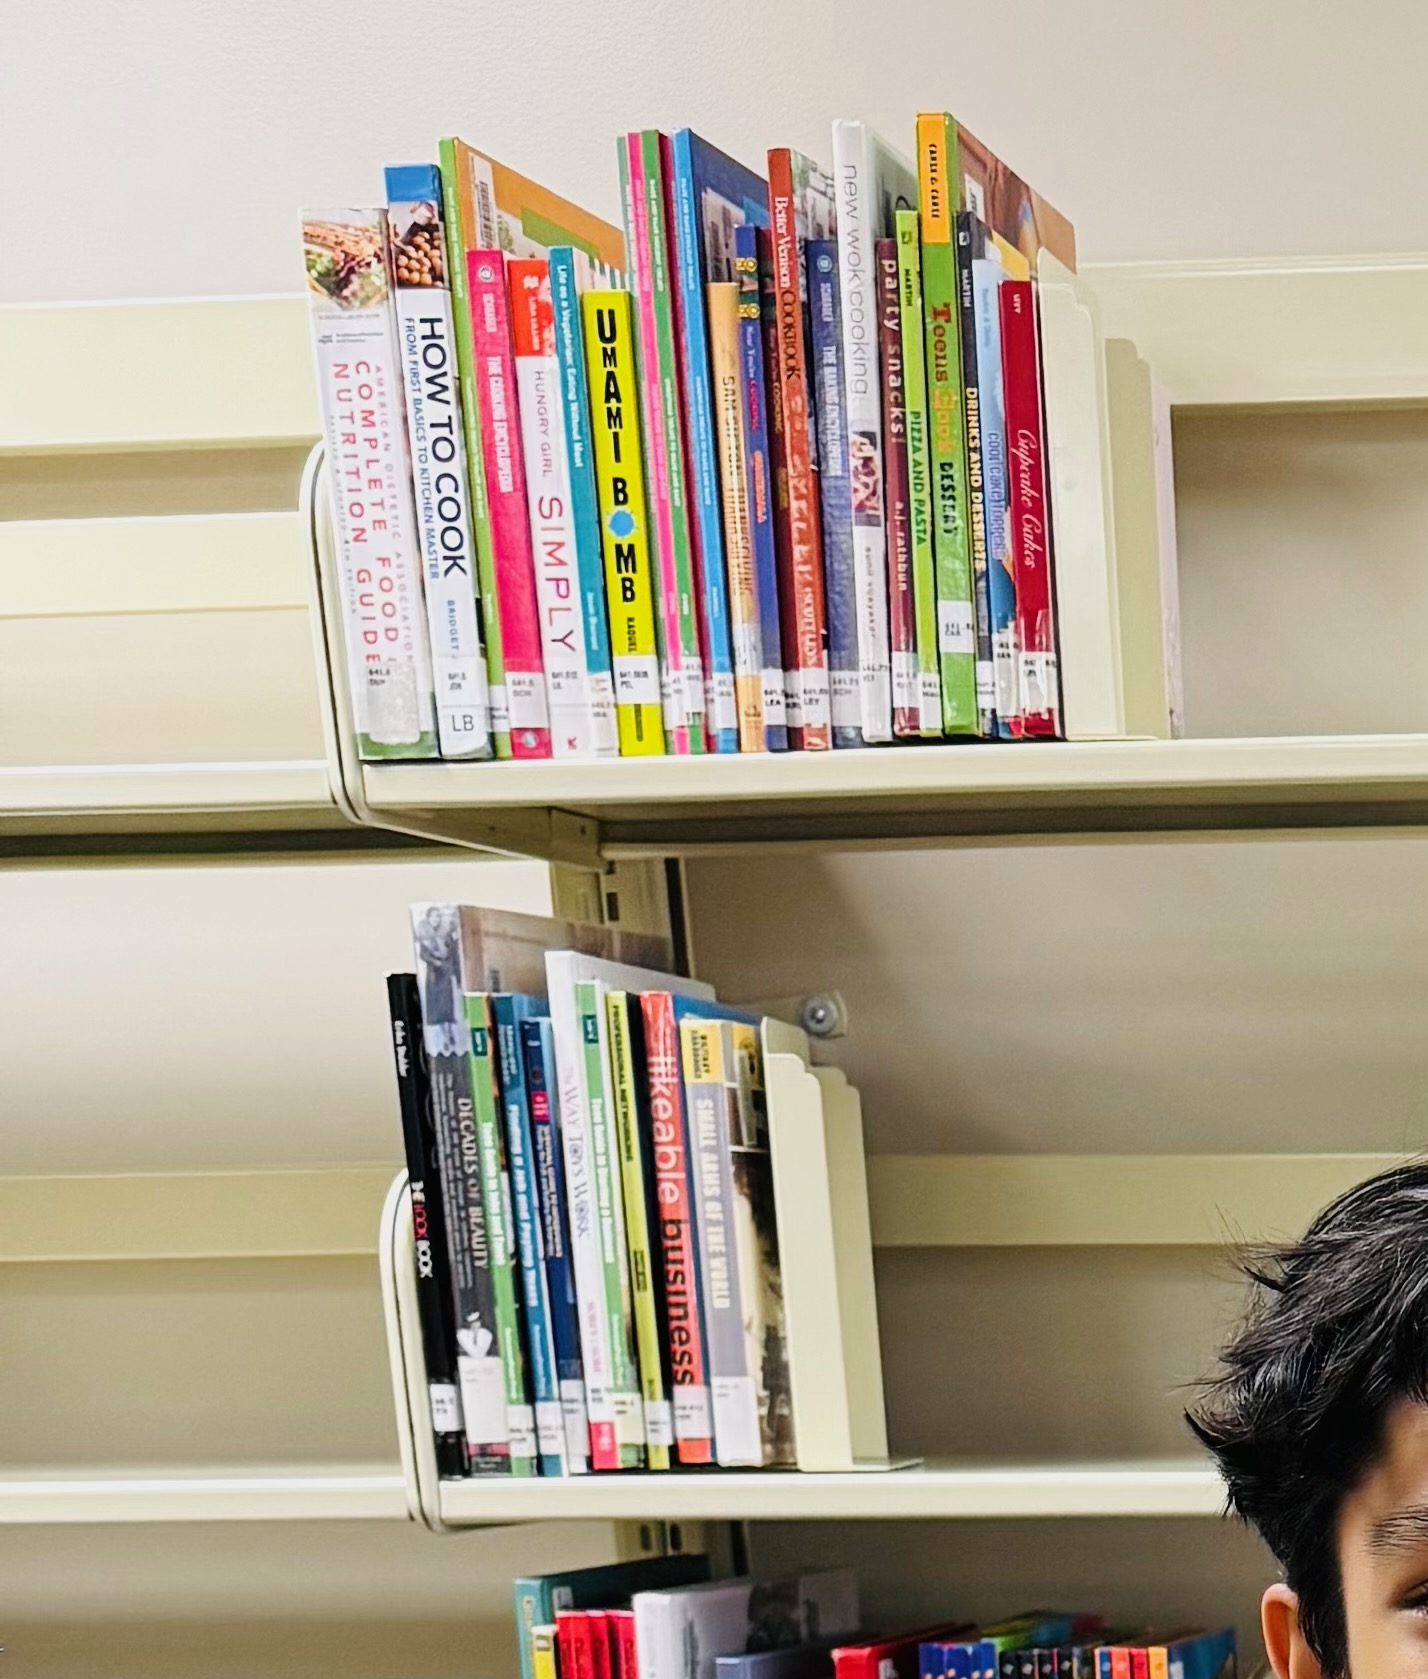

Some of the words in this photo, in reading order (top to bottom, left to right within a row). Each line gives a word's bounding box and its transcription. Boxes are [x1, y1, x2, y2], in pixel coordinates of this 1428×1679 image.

[775, 196, 790, 233] Better
[842, 165, 860, 220] new
[777, 236, 791, 287] Venison
[848, 229, 865, 281] wok
[881, 259, 905, 331] party
[404, 317, 418, 355] FROM
[419, 317, 451, 405] HOW
[781, 289, 800, 380] COOKBOOK
[850, 289, 871, 394] cooking
[931, 303, 952, 382] Teens
[409, 361, 422, 393] FIRST
[534, 370, 549, 437] HUNGRY
[596, 308, 624, 463] UMAMI
[412, 398, 427, 442] BASICS
[431, 415, 456, 463] TO
[910, 411, 923, 454] PIZZA
[966, 387, 981, 448] DRINKS
[418, 448, 430, 464] TO
[912, 459, 925, 493] AND
[969, 452, 983, 487] AND
[1010, 429, 1038, 506] Cupcake
[333, 363, 367, 543] NUTRITION
[356, 569, 380, 663] GUIDE
[356, 360, 387, 531] COMPLETE
[376, 557, 399, 642] FOOD
[419, 468, 434, 524] KITCHEN
[914, 499, 928, 545] PASTA
[940, 461, 959, 537] DESSERT
[435, 473, 468, 578] COOK
[970, 491, 987, 572] DESSERTS
[1022, 514, 1044, 569] Cakes
[424, 529, 440, 579] MASTER
[539, 496, 576, 652] SIMPLY
[447, 600, 460, 651] BRIDGET
[452, 716, 475, 732] LB
[458, 1098, 478, 1173] DECADES
[648, 1055, 686, 1204] likeable
[695, 1098, 717, 1148] SMALL
[468, 1179, 479, 1198] OF
[700, 1152, 721, 1196] ARMS
[470, 1206, 488, 1269] BEAUTY
[705, 1201, 723, 1221] OF
[710, 1227, 728, 1253] THE
[662, 1219, 695, 1386] business
[711, 1258, 731, 1308] WORLD
